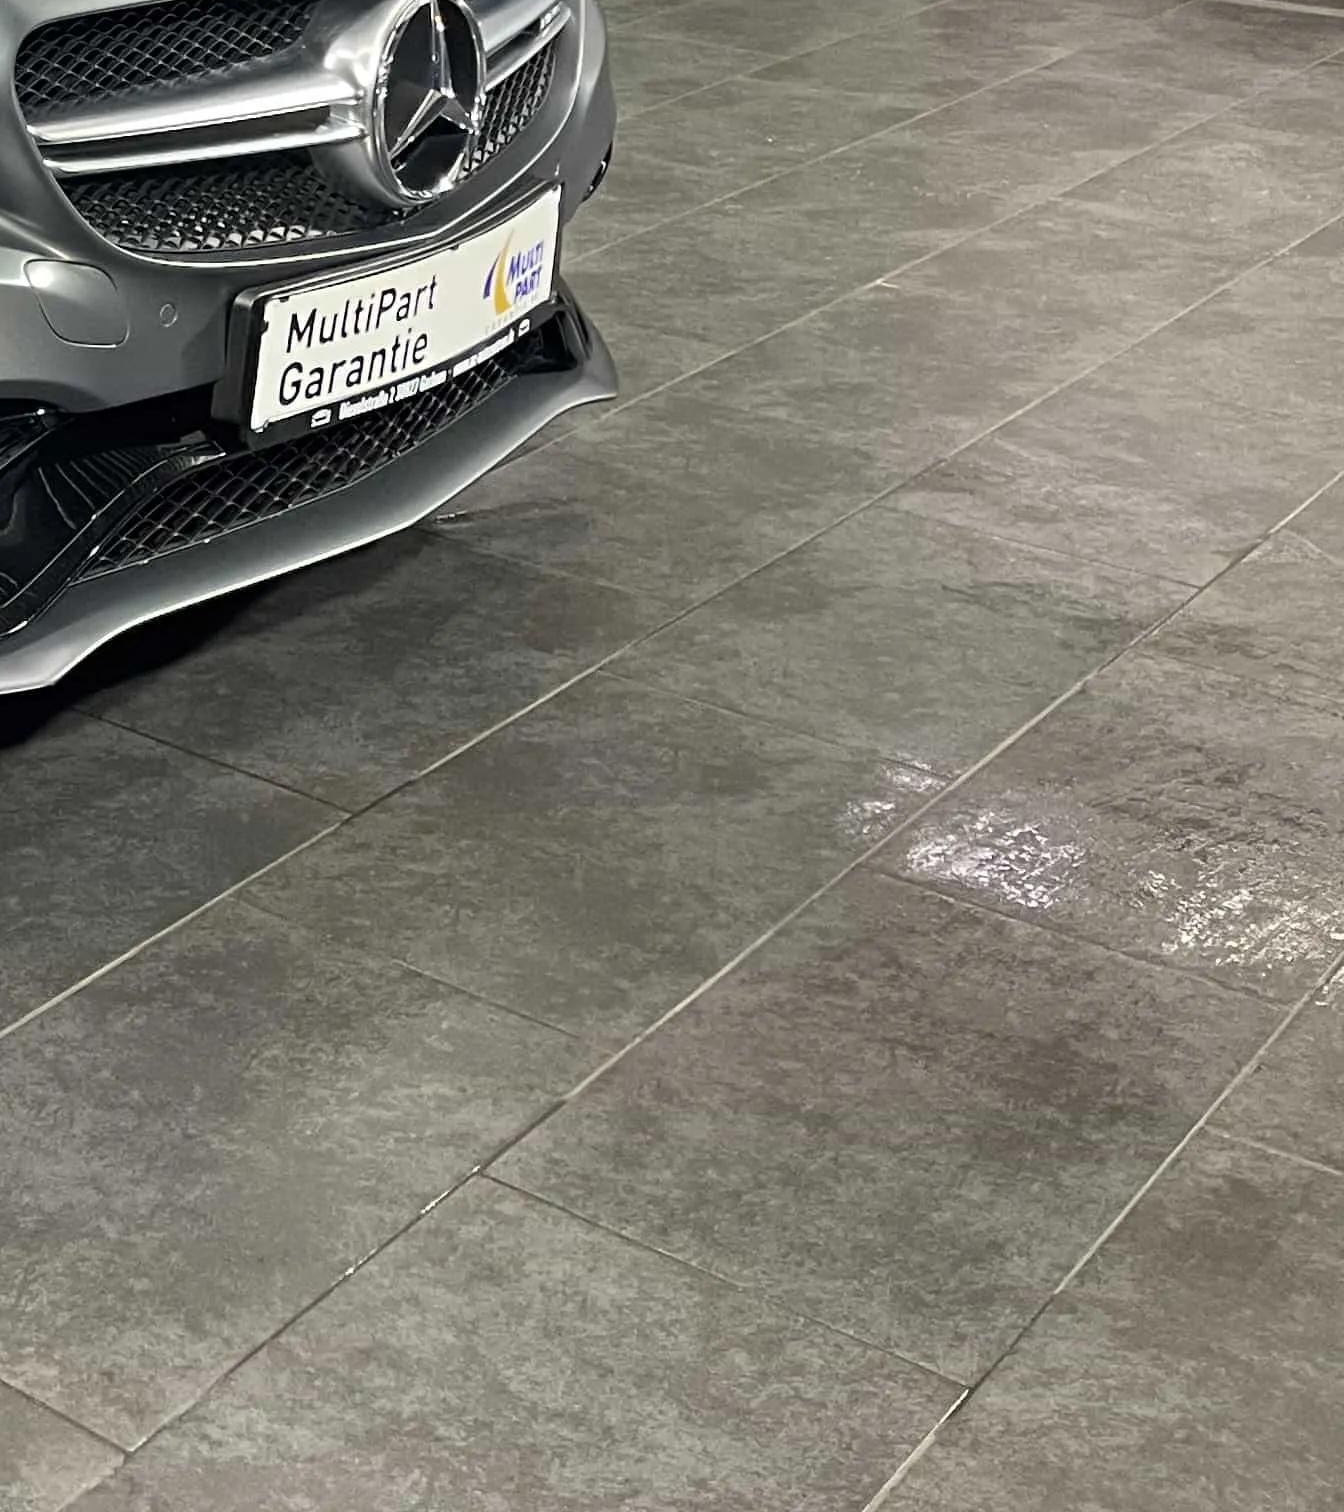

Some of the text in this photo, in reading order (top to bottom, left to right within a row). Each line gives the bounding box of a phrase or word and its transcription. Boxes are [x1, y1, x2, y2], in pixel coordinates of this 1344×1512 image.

[507, 239, 545, 287] MULTI
[513, 265, 542, 304] PART
[287, 274, 438, 353] MultiPart
[279, 327, 429, 405] Garantie
